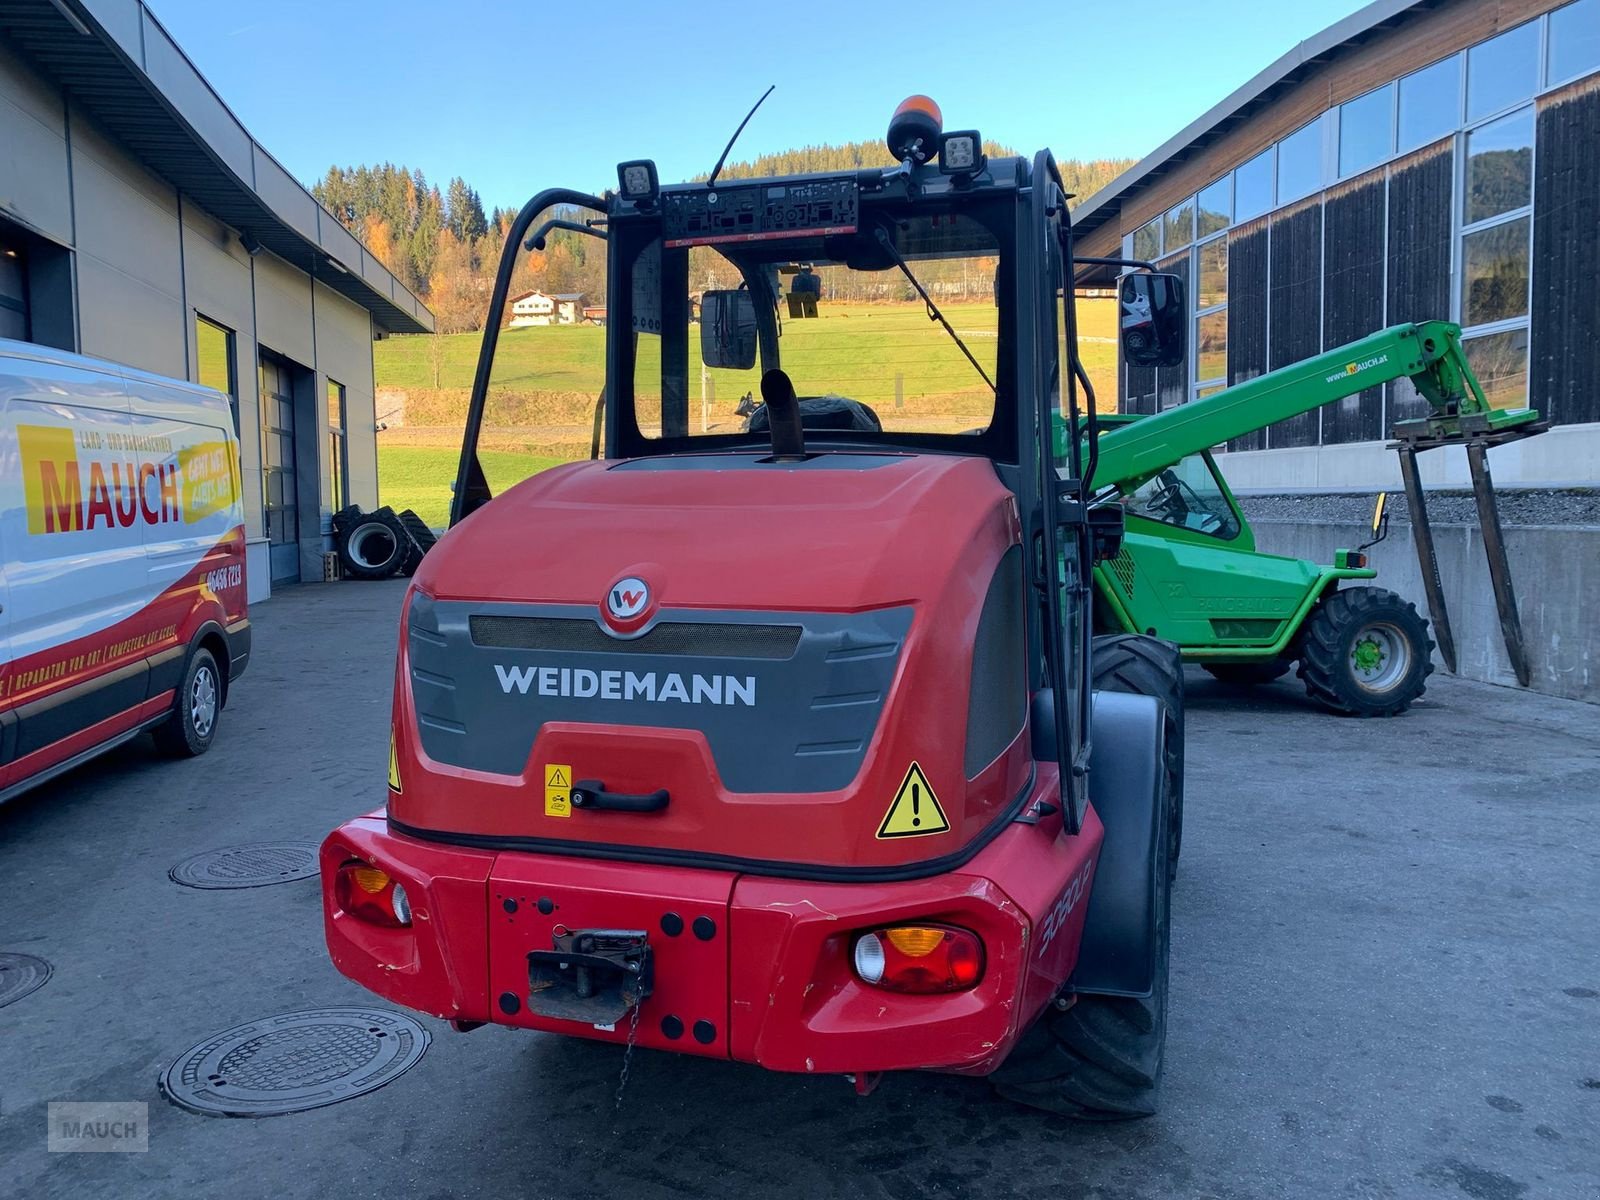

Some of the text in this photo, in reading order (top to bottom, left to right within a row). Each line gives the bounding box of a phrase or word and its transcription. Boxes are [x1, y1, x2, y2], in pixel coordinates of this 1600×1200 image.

[1326, 354, 1388, 383] www.MAUCH.at
[39, 460, 178, 533] MAUCH
[494, 665, 756, 706] WEIDEMANN
